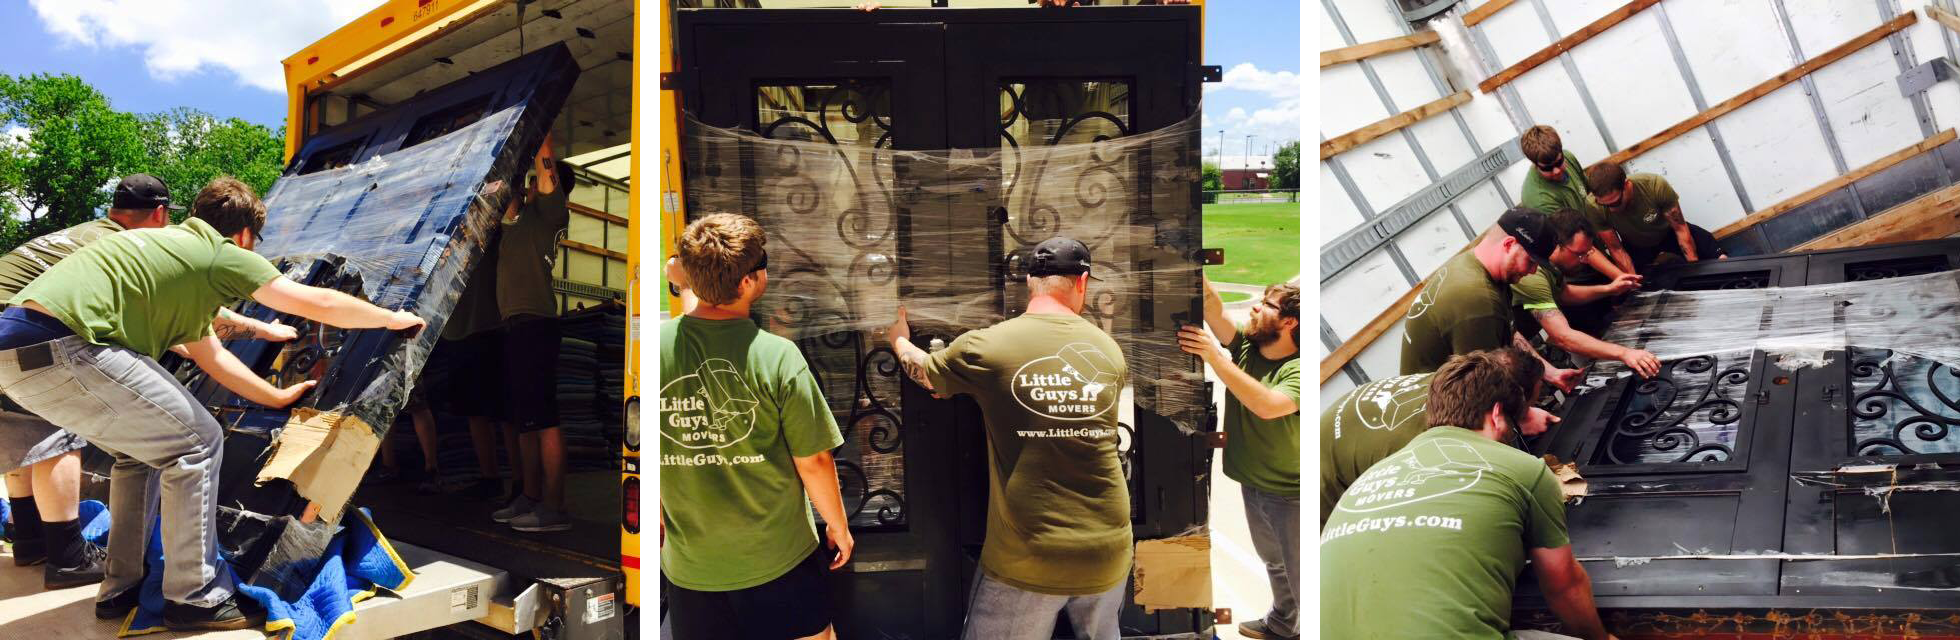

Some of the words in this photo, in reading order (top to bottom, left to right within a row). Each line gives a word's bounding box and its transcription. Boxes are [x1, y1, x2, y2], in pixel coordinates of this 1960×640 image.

[1019, 373, 1072, 387] Little
[1030, 387, 1078, 403] Guys
[660, 397, 705, 411] Little
[1048, 404, 1096, 413] MOVERS
[668, 413, 709, 430] Guys
[1017, 428, 1116, 439] www.LittleGuys.c
[1355, 488, 1416, 507] MOVERS
